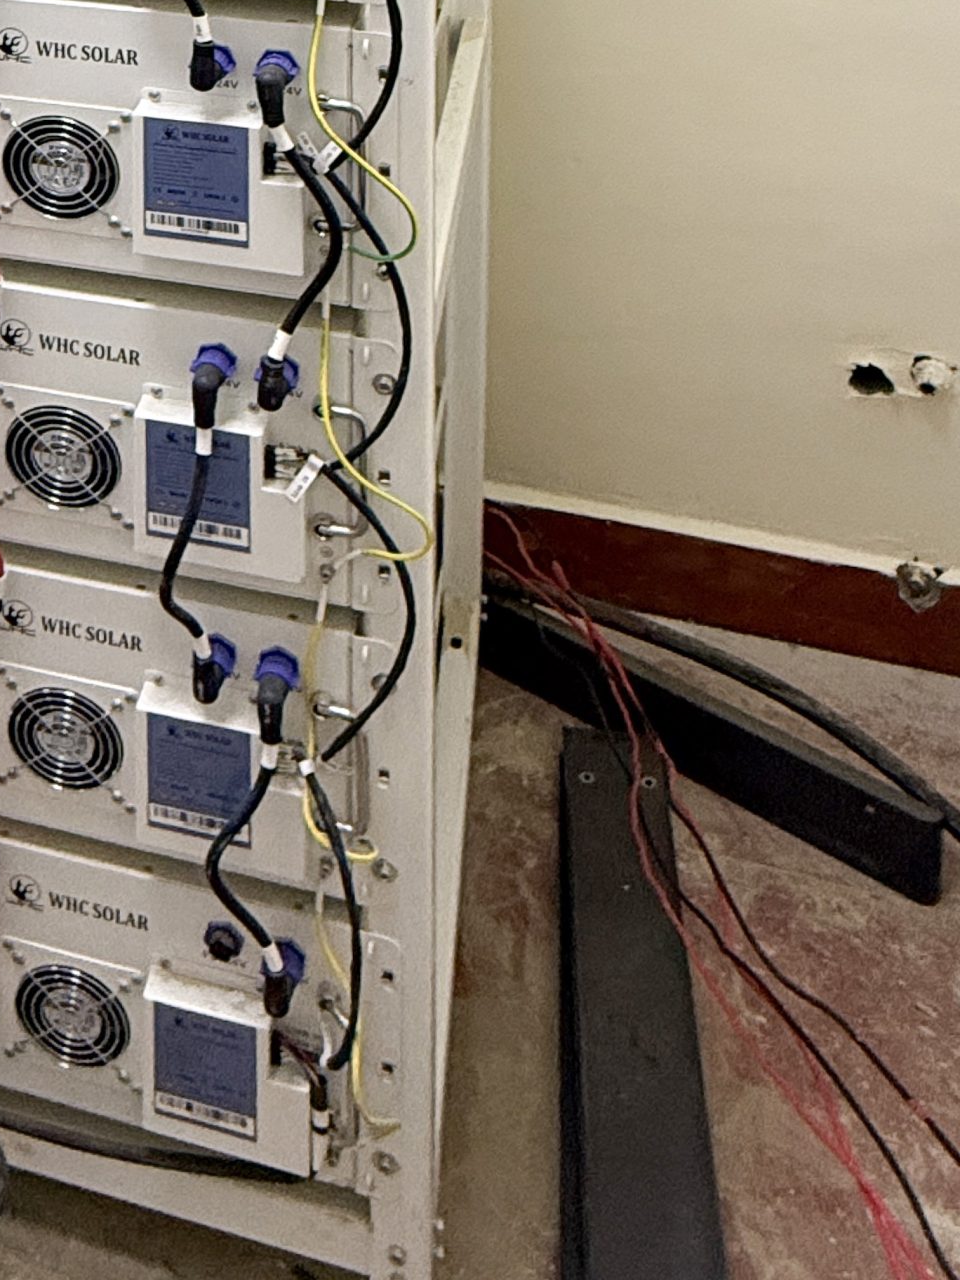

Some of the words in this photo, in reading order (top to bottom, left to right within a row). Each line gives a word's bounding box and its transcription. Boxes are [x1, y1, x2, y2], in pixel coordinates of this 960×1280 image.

[36, 40, 77, 59] WHC
[81, 45, 139, 65] SOLAR
[39, 334, 80, 355] WHC
[83, 341, 140, 366] SOLAR
[41, 616, 81, 638] WHC
[86, 626, 143, 651] SOLAR
[48, 892, 89, 915] WHC
[92, 904, 148, 931] SOLAR
